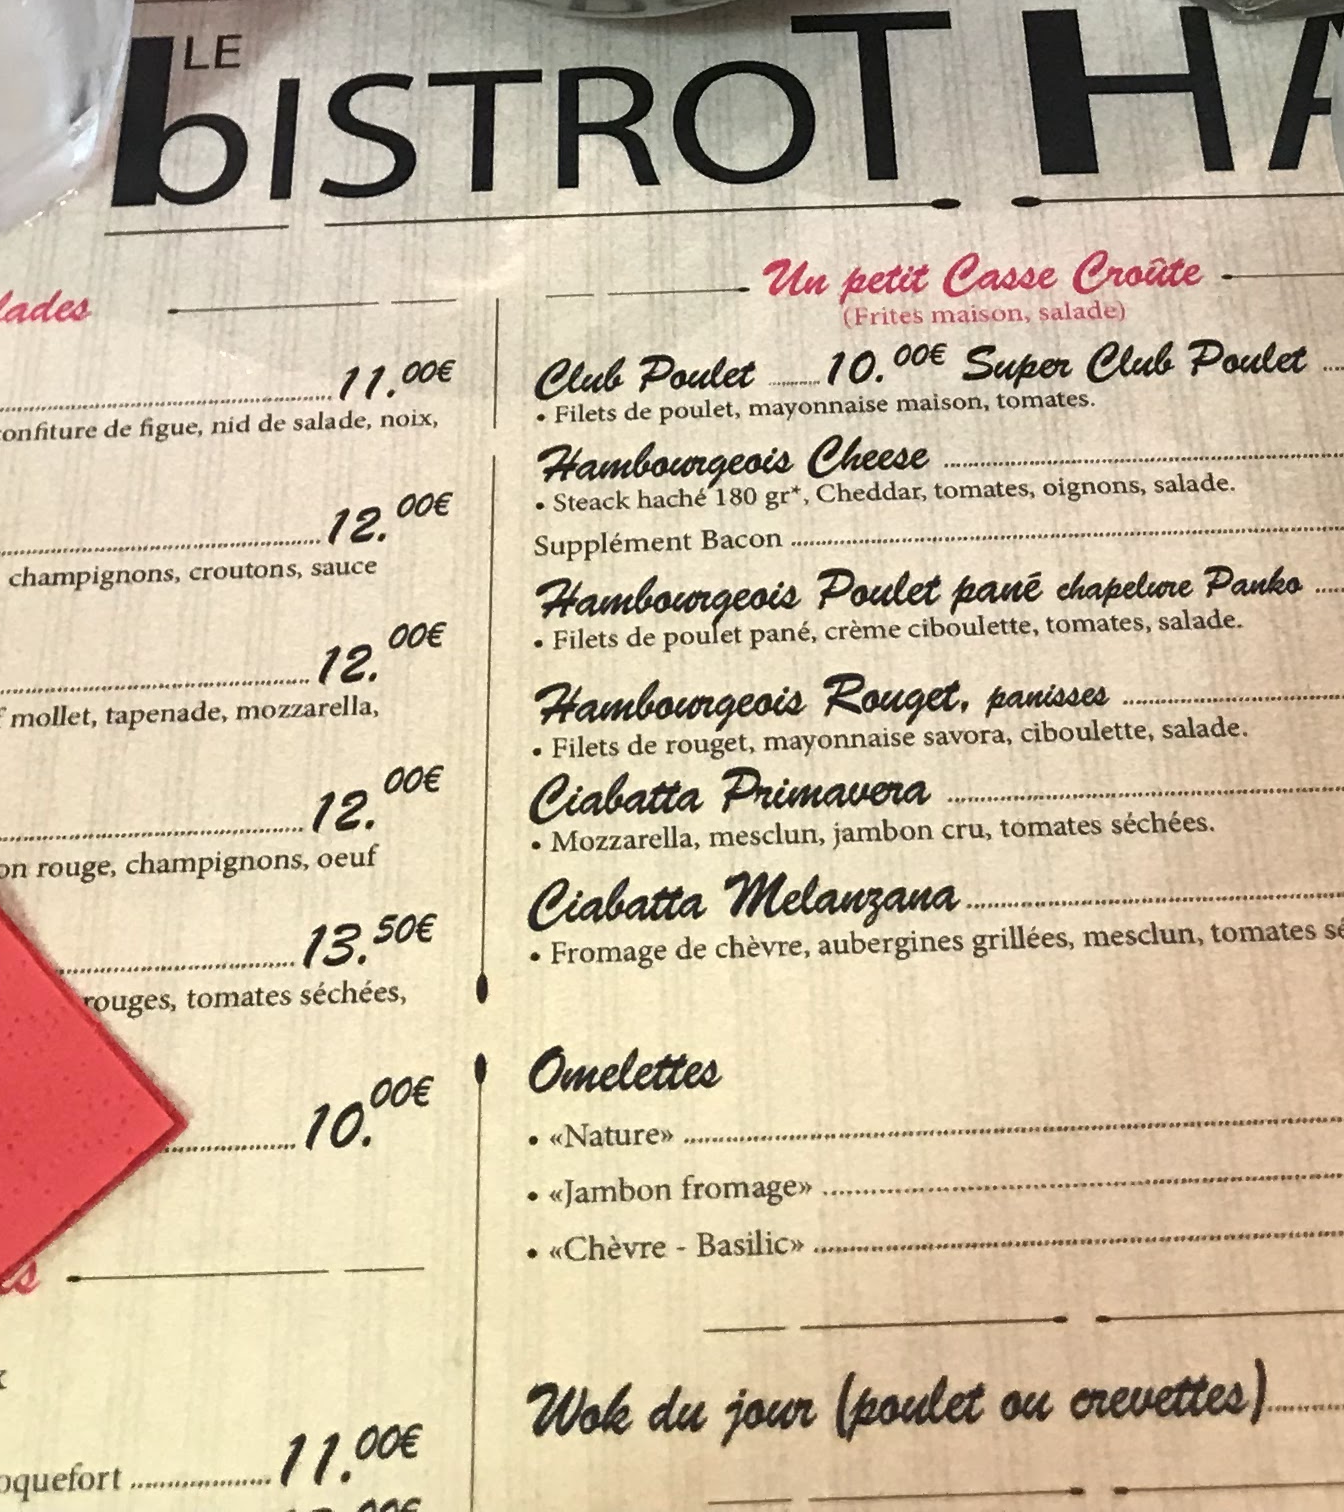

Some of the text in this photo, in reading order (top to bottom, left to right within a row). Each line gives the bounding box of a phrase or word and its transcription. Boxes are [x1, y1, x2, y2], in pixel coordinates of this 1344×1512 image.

[184, 34, 242, 70] LE
[763, 250, 1204, 306] Un petit Casse Croûte
[844, 300, 1125, 329] (Frites maison, salade)
[534, 356, 626, 401] Club
[639, 354, 756, 393] Poulet
[962, 345, 1073, 389] Super
[1086, 341, 1175, 383] Club
[1188, 339, 1307, 377] Poulet
[104, 419, 131, 438] de
[140, 417, 202, 443] figue,
[211, 415, 250, 435] nid
[258, 413, 286, 432] de
[293, 410, 371, 431] salade,
[380, 414, 437, 428] noix,
[555, 392, 1095, 425] Filets de poulet, mayonnaise maison, tomates.
[537, 441, 794, 489] Hambourgeois
[807, 435, 930, 479] Cheese
[534, 532, 692, 561] Supplément
[701, 530, 783, 550] Bacon
[9, 566, 180, 591] champignons,
[189, 563, 302, 580] croutons,
[311, 561, 377, 576] sauce
[535, 575, 801, 633] Hambourgeois
[817, 568, 941, 610] Poulet
[1203, 565, 1303, 598] Panko
[534, 679, 807, 732] Hambourgeois
[823, 673, 969, 726] Rouget,
[985, 684, 1110, 717] panisses
[529, 772, 704, 825] Ciabatta
[722, 766, 931, 813] Primavera
[527, 877, 707, 932] Ciabatta
[724, 871, 961, 928] Melanzana
[551, 942, 667, 969] Fromage
[676, 936, 706, 960] de
[716, 935, 810, 959] chèvre,
[818, 930, 964, 960] aubergines
[972, 925, 1074, 958] grillées,
[1083, 921, 1204, 947] mesclun,
[1210, 922, 1317, 943] tomates
[529, 1045, 722, 1094] Omelettes
[549, 1177, 671, 1208] «Jambon
[682, 1175, 812, 1206] fromage»
[527, 1382, 633, 1437] Wok
[648, 1385, 708, 1433] du
[721, 1388, 817, 1448] jour
[835, 1371, 985, 1443] (poulet
[1000, 1390, 1054, 1422] ou
[1070, 1358, 1267, 1426] crevettes)
